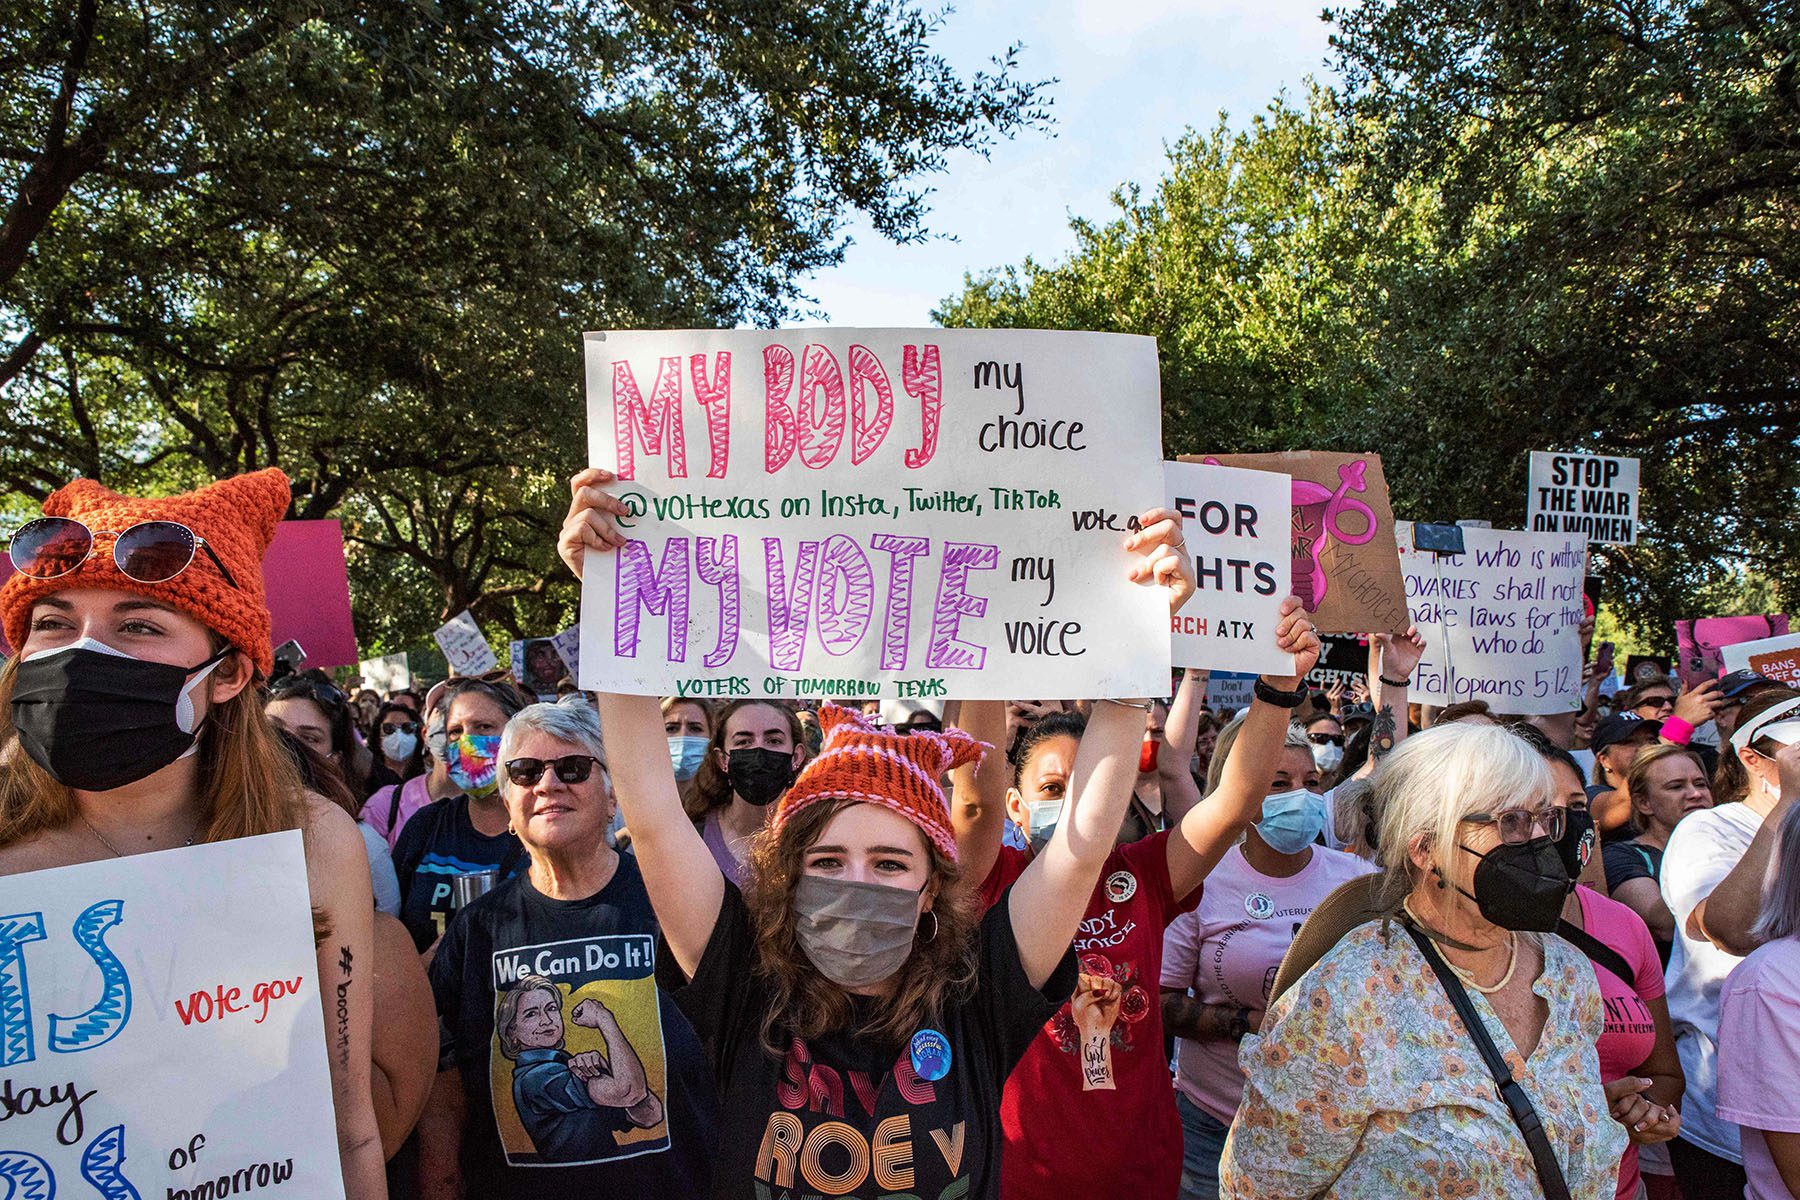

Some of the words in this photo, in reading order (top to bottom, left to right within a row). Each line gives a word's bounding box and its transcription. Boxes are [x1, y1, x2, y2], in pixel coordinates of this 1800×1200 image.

[974, 360, 1025, 415] my
[612, 351, 731, 481] MY
[764, 343, 944, 475] BODY
[978, 415, 1087, 453] choice
[1551, 456, 1619, 488] STOP
[780, 495, 812, 519] on
[821, 489, 900, 522] Insta,
[1538, 487, 1577, 512] THE
[1581, 490, 1631, 515] WAR
[1174, 497, 1259, 539] FOR
[1533, 513, 1559, 533] ON
[1562, 515, 1633, 542] WOMEN
[1476, 540, 1521, 568] who
[1531, 546, 1545, 570] is
[1011, 553, 1056, 607] my
[1196, 555, 1278, 597] HTS
[1405, 574, 1480, 600] OVARIES
[1493, 576, 1544, 601] shall
[1552, 582, 1577, 601] not
[614, 534, 740, 669] MY
[762, 533, 1001, 671] VOTE
[1470, 606, 1516, 628] laws
[1525, 606, 1557, 630] for
[1004, 618, 1087, 657] voice
[1171, 615, 1208, 636] RCH
[1216, 620, 1254, 640] ATX
[1472, 630, 1517, 655] who
[1416, 663, 1526, 701] Fallopians
[1761, 659, 1797, 674] BANS
[676, 677, 752, 698] VOTERS
[763, 677, 787, 696] OF
[792, 678, 882, 697] TOMORROW
[893, 678, 949, 698] TEXAS
[1221, 680, 1243, 691] Don't
[1079, 909, 1117, 935] ODY
[495, 954, 532, 985] We
[534, 950, 581, 978] Can
[584, 943, 621, 972] Do
[624, 941, 653, 968] It!
[174, 976, 303, 1024] vote.gov
[1603, 1023, 1626, 1034] OMEN
[168, 1133, 206, 1171] of
[754, 1111, 915, 1195] ROE
